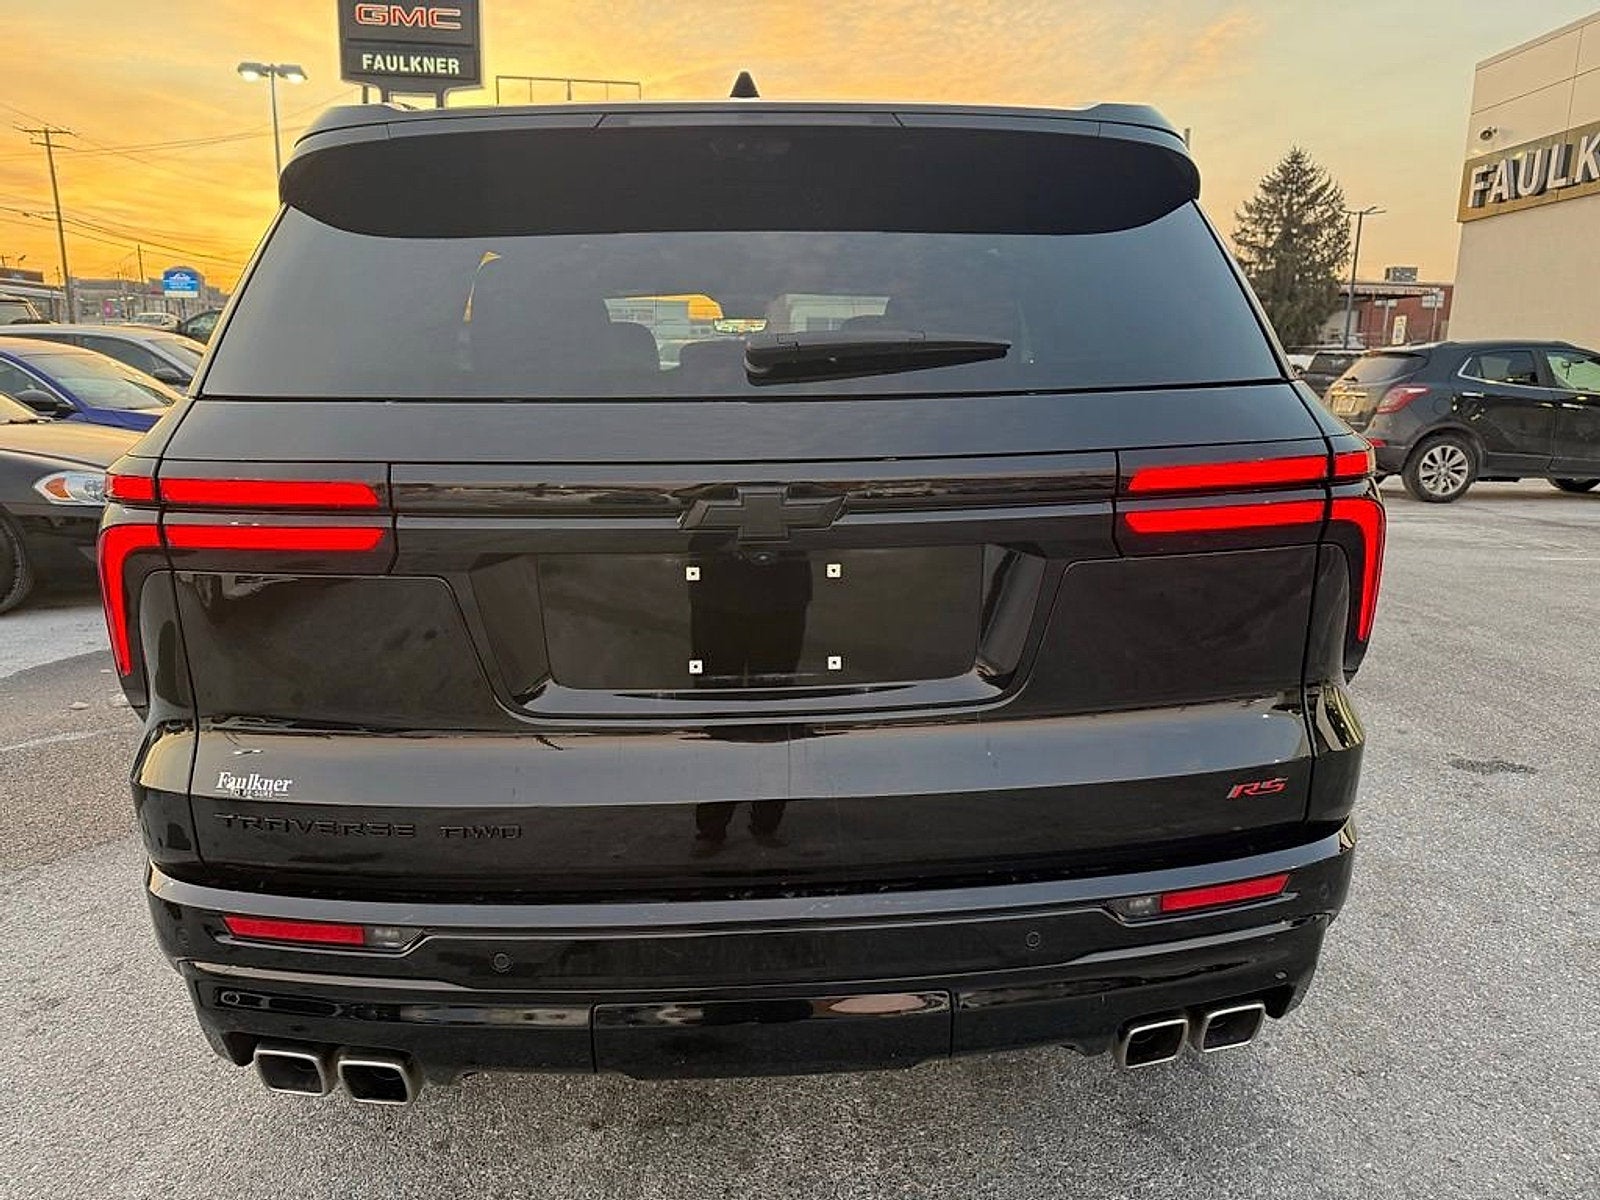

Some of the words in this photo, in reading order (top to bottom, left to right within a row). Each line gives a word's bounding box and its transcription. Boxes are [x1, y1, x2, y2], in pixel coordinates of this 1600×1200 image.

[355, 3, 462, 30] GMC
[362, 53, 461, 75] FAULKNER
[1467, 131, 1600, 208] FAULK
[215, 771, 294, 792] Faulkner
[1226, 776, 1289, 800] RS
[213, 812, 416, 839] TRAVERSE
